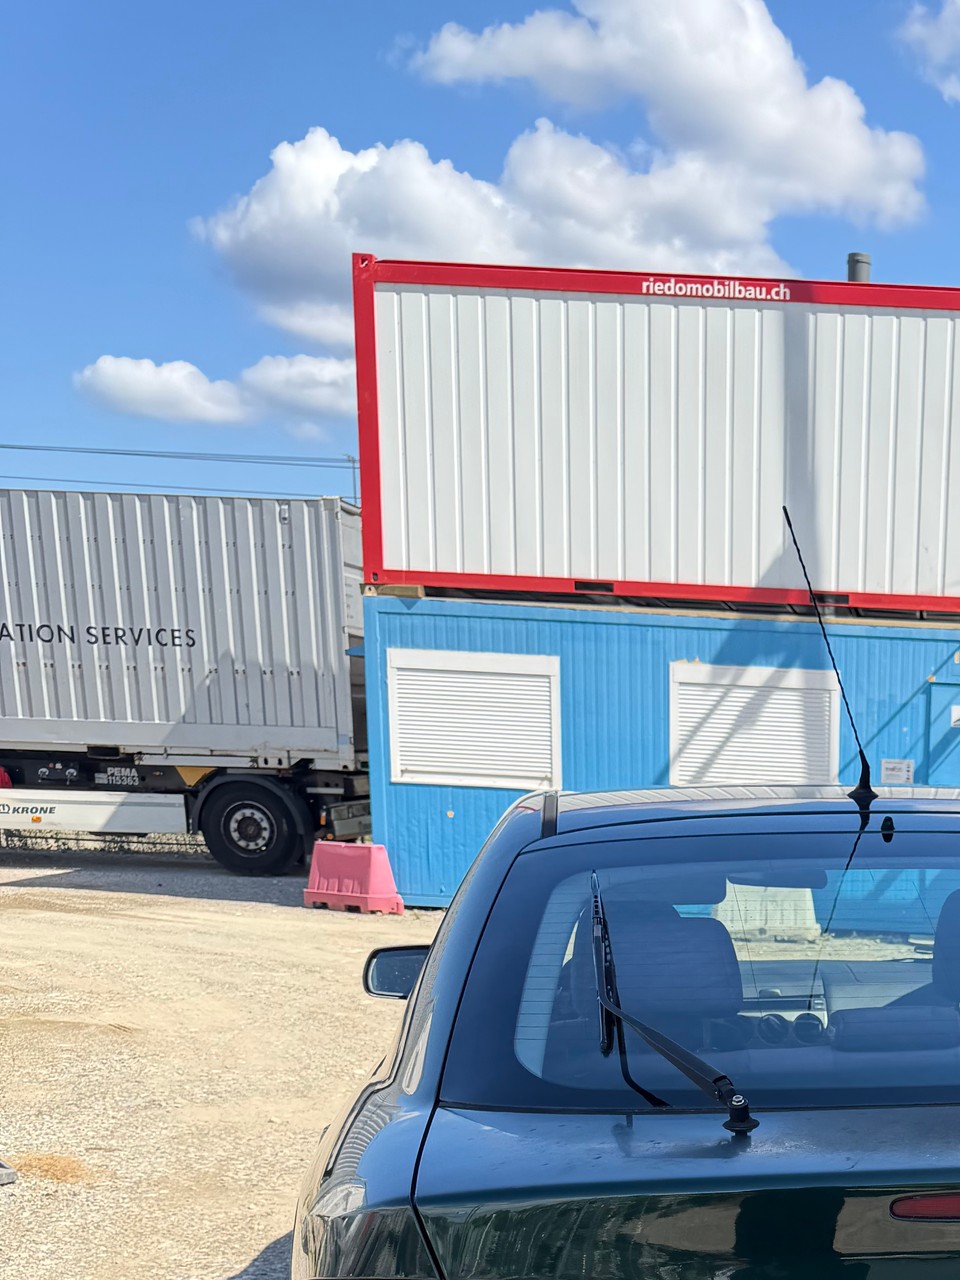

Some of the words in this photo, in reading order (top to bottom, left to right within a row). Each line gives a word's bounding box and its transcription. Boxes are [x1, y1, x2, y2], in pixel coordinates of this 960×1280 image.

[641, 277, 791, 300] riedomobilbau.ch
[0, 622, 76, 644] ATION
[86, 626, 196, 648] SERVICES
[106, 767, 139, 777] PEMA
[108, 776, 140, 786] 115363
[12, 806, 56, 815] KRONE
